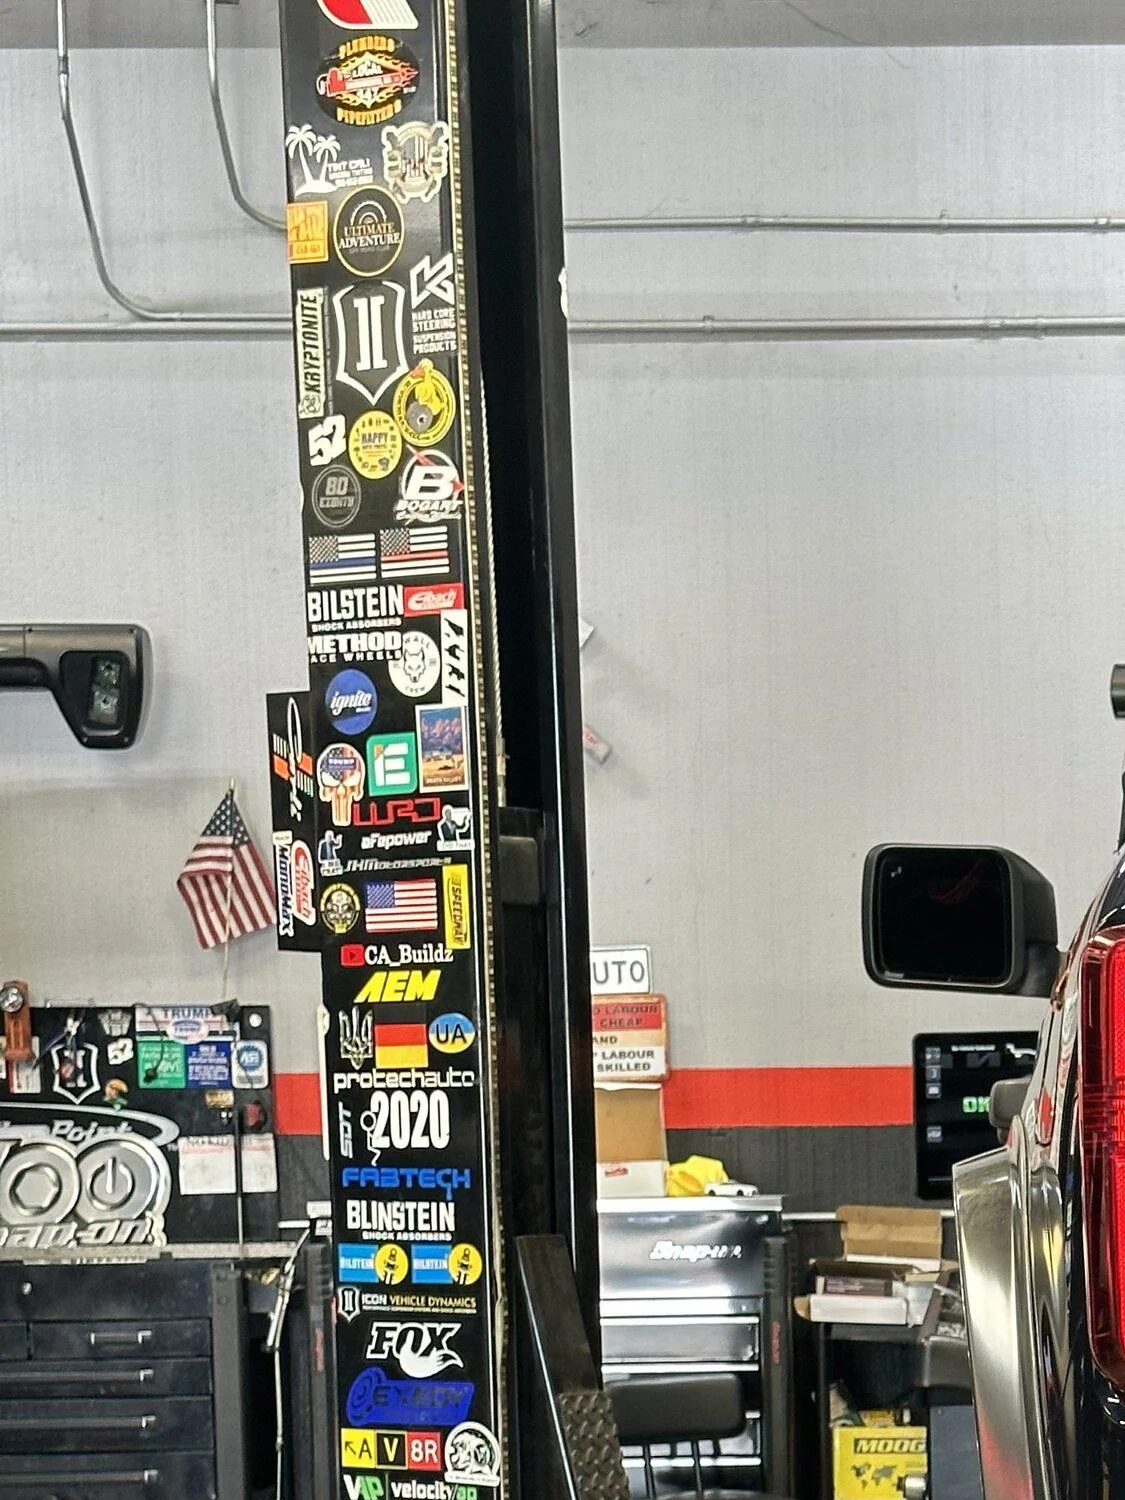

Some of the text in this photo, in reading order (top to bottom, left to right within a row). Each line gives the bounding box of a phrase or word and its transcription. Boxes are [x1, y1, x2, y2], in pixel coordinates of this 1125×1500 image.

[344, 221, 395, 237] ULTIMATE
[339, 232, 401, 249] ADVENTURE
[412, 319, 456, 332] STEERING
[300, 291, 322, 395] KRYPTONITE
[413, 341, 457, 355] PRODUCTS
[361, 432, 389, 444] HAPPY
[307, 584, 404, 622] BILSTEIN
[311, 617, 402, 633] SHOCK ABSORBERS
[307, 631, 402, 655] METHOD
[309, 649, 402, 664] ACE WHEELS
[330, 690, 373, 716] ignite
[364, 943, 454, 967] CA_Buildz
[592, 960, 645, 985] UTO
[353, 970, 441, 1004] AEM
[605, 1005, 657, 1015] LABOUR
[600, 1017, 644, 1028] CHEAP
[436, 1023, 467, 1045] UA
[602, 1050, 655, 1060] LABOUR
[597, 1063, 651, 1072] SKILLED
[334, 1066, 475, 1095] protechauto
[370, 1089, 450, 1149] 2020
[52, 1119, 133, 1142] Point
[342, 1168, 472, 1190] FABTECH
[346, 1199, 456, 1232] BLINSTEIN
[362, 1231, 452, 1241] SHOCK ABSORBERS
[362, 1293, 477, 1308] ICON VEHICLE DYNAMICS
[366, 1322, 464, 1372] FOX
[856, 1438, 927, 1453] MOOG
